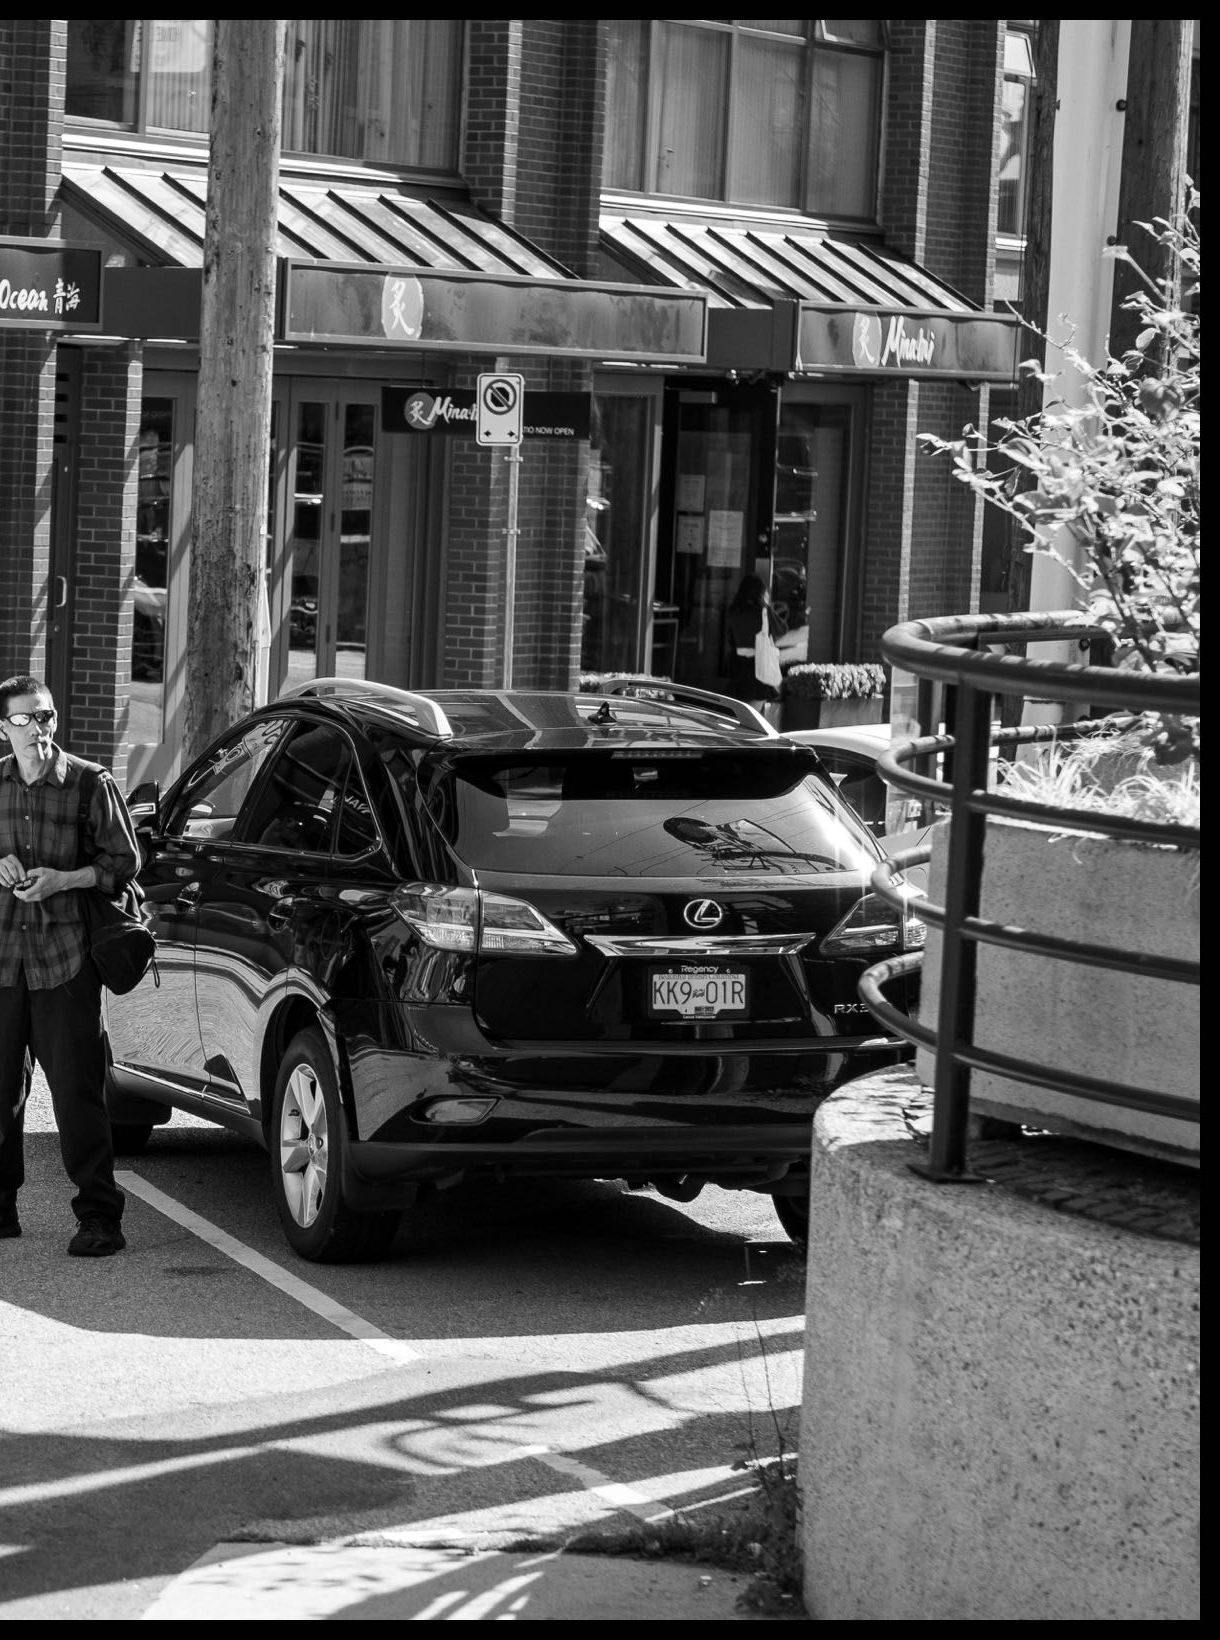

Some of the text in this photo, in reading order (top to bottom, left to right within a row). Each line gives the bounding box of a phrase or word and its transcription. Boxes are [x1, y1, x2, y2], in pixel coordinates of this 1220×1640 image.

[535, 426, 553, 435] NOW
[554, 426, 575, 436] OPEN
[680, 965, 719, 974] Regency
[834, 1003, 869, 1014] RX3
